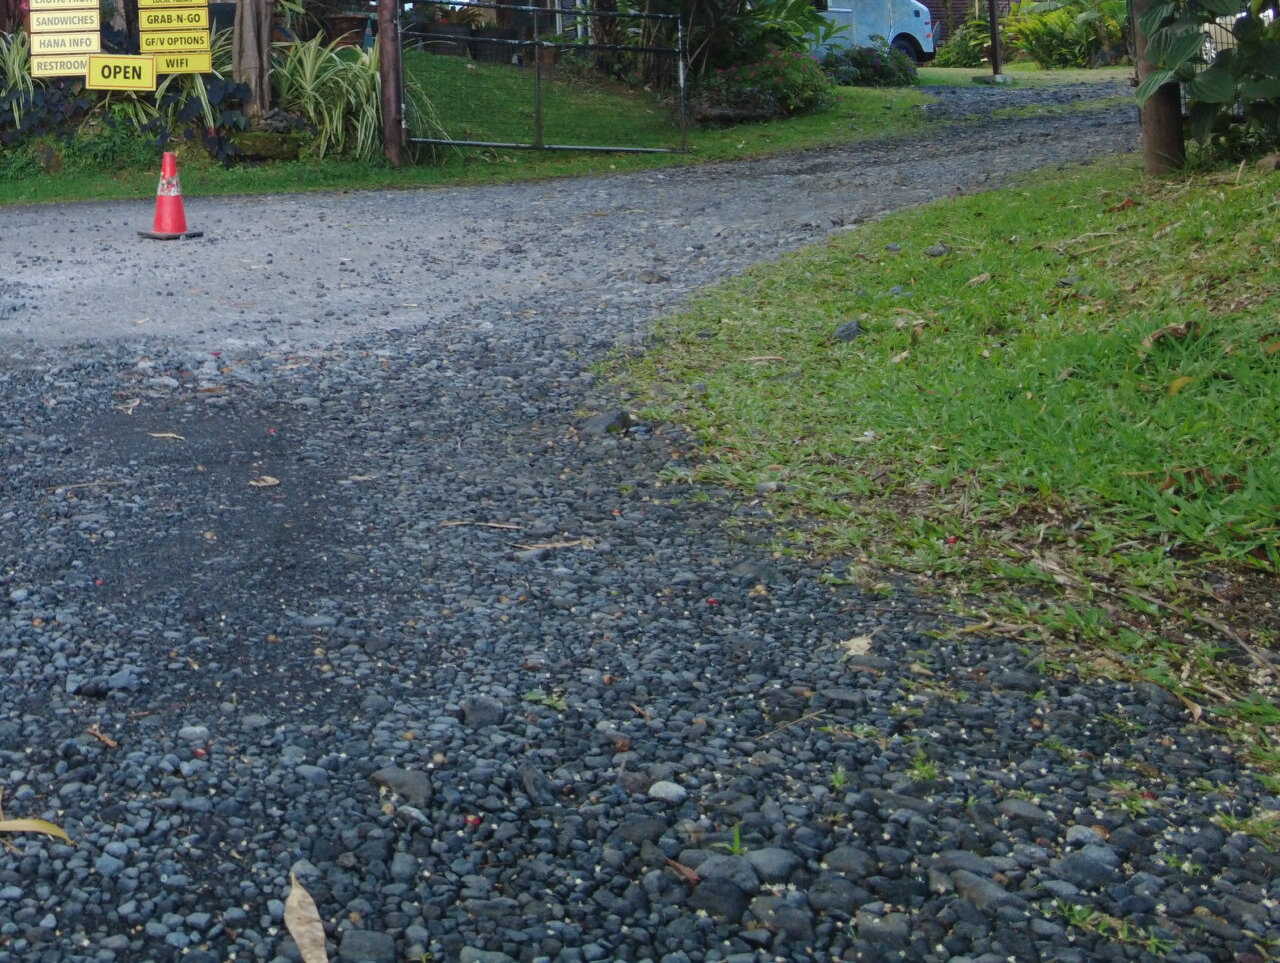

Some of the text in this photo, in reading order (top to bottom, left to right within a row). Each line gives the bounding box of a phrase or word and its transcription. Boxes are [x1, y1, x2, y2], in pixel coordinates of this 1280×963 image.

[35, 15, 95, 27] SANDWICHES
[147, 13, 201, 25] GRAB-N-GO
[39, 37, 93, 49] HANA INFO
[145, 35, 205, 47] GF/V OPTIONS
[165, 59, 189, 69] WIFI
[101, 65, 142, 80] OPEN
